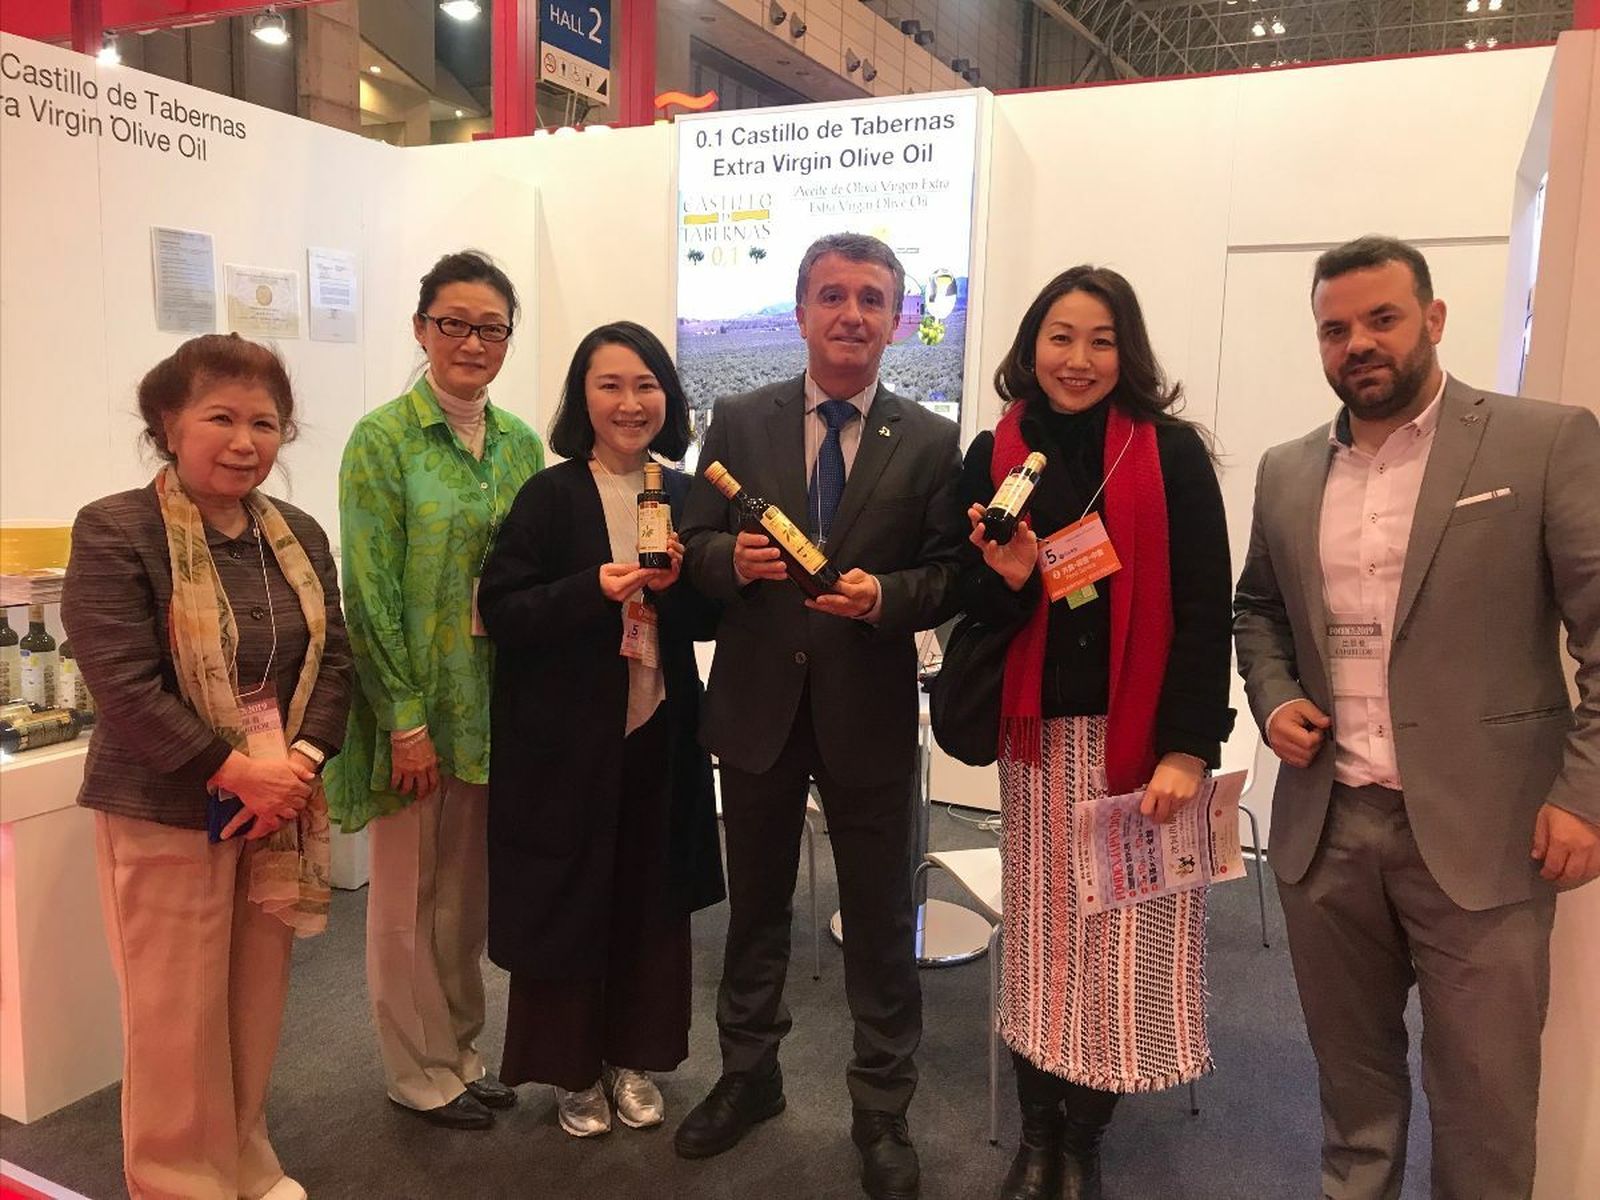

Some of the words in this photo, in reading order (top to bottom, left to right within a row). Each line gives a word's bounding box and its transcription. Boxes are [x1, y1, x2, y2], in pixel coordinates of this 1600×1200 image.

[550, 3, 585, 36] HALL
[588, 7, 602, 44] 2
[1, 53, 98, 99] Castillo
[107, 82, 137, 110] de
[144, 90, 246, 139] Tabernas
[29, 95, 102, 136] Virgin
[112, 117, 170, 152] Olive
[178, 134, 207, 161] Oil
[695, 129, 723, 148] 0.1
[731, 122, 809, 146] Castillo
[816, 120, 843, 140] de
[851, 113, 955, 136] Tabernas
[713, 158, 765, 177] Extra
[772, 151, 832, 175] Virgin
[839, 148, 894, 168] Olive
[902, 143, 933, 164] Oil
[683, 193, 772, 212] CASTILLO
[831, 183, 844, 195] de
[846, 181, 877, 194] Oliva
[880, 179, 918, 194] Virgen
[921, 177, 950, 190] Extra
[684, 224, 771, 242] TABERNAS
